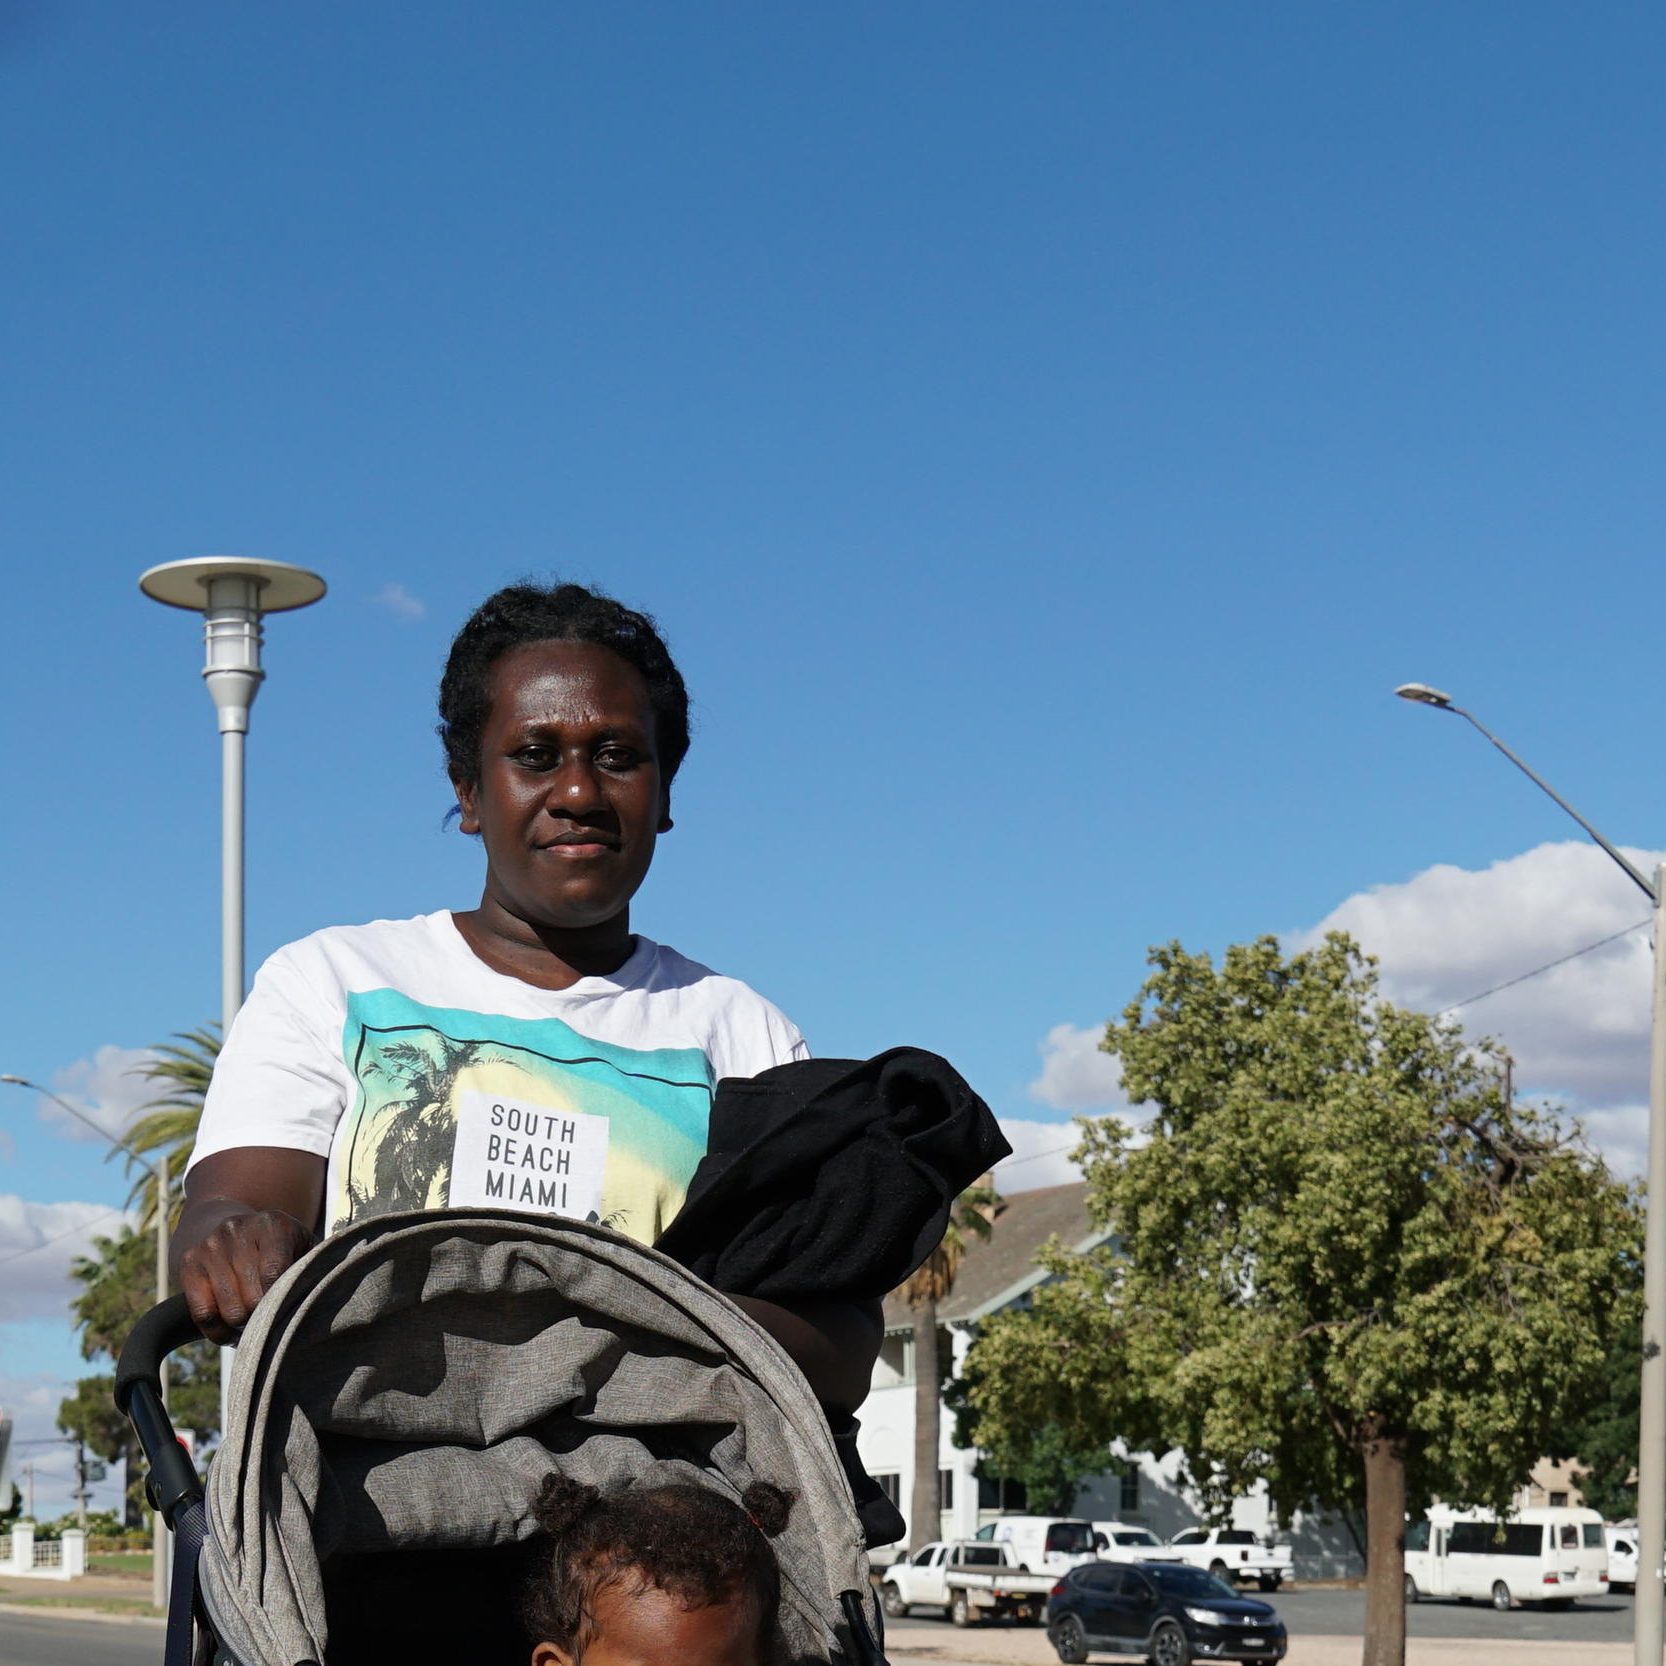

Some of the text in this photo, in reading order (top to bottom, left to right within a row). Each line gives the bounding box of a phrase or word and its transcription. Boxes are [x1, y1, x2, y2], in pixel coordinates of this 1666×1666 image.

[491, 1104, 575, 1144] SOUTH
[487, 1134, 571, 1175] BEACH
[485, 1169, 567, 1209] MIAMI
